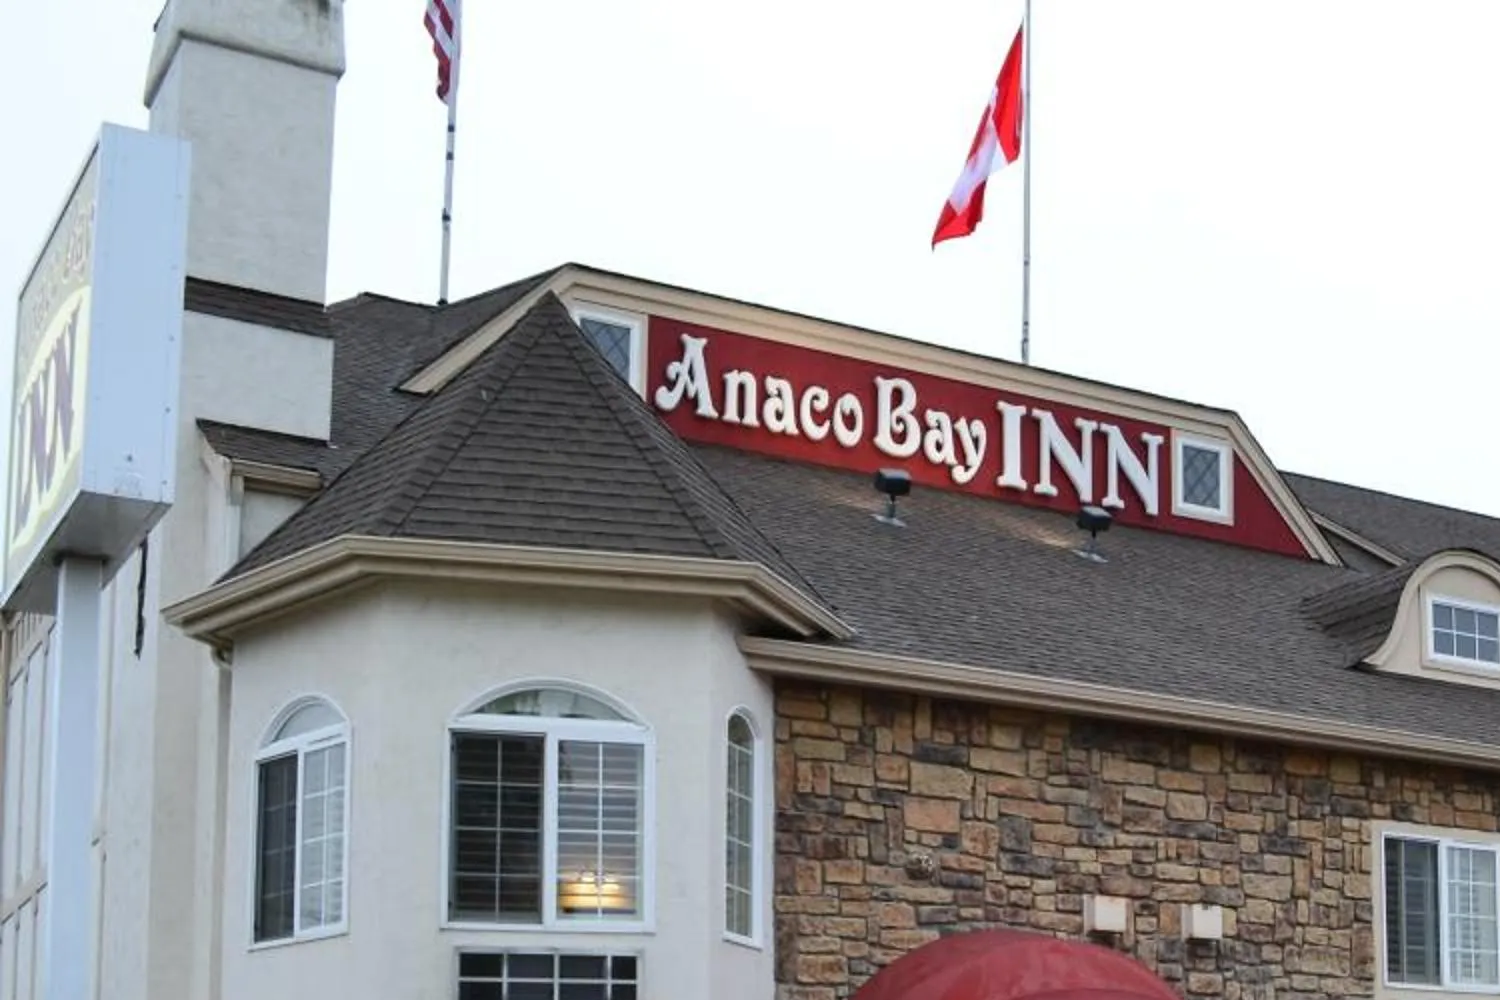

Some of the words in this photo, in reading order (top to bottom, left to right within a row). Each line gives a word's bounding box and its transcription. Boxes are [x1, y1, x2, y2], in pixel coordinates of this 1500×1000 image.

[654, 333, 864, 449] Anaco
[873, 374, 988, 485] Bay
[996, 400, 1165, 517] INN
